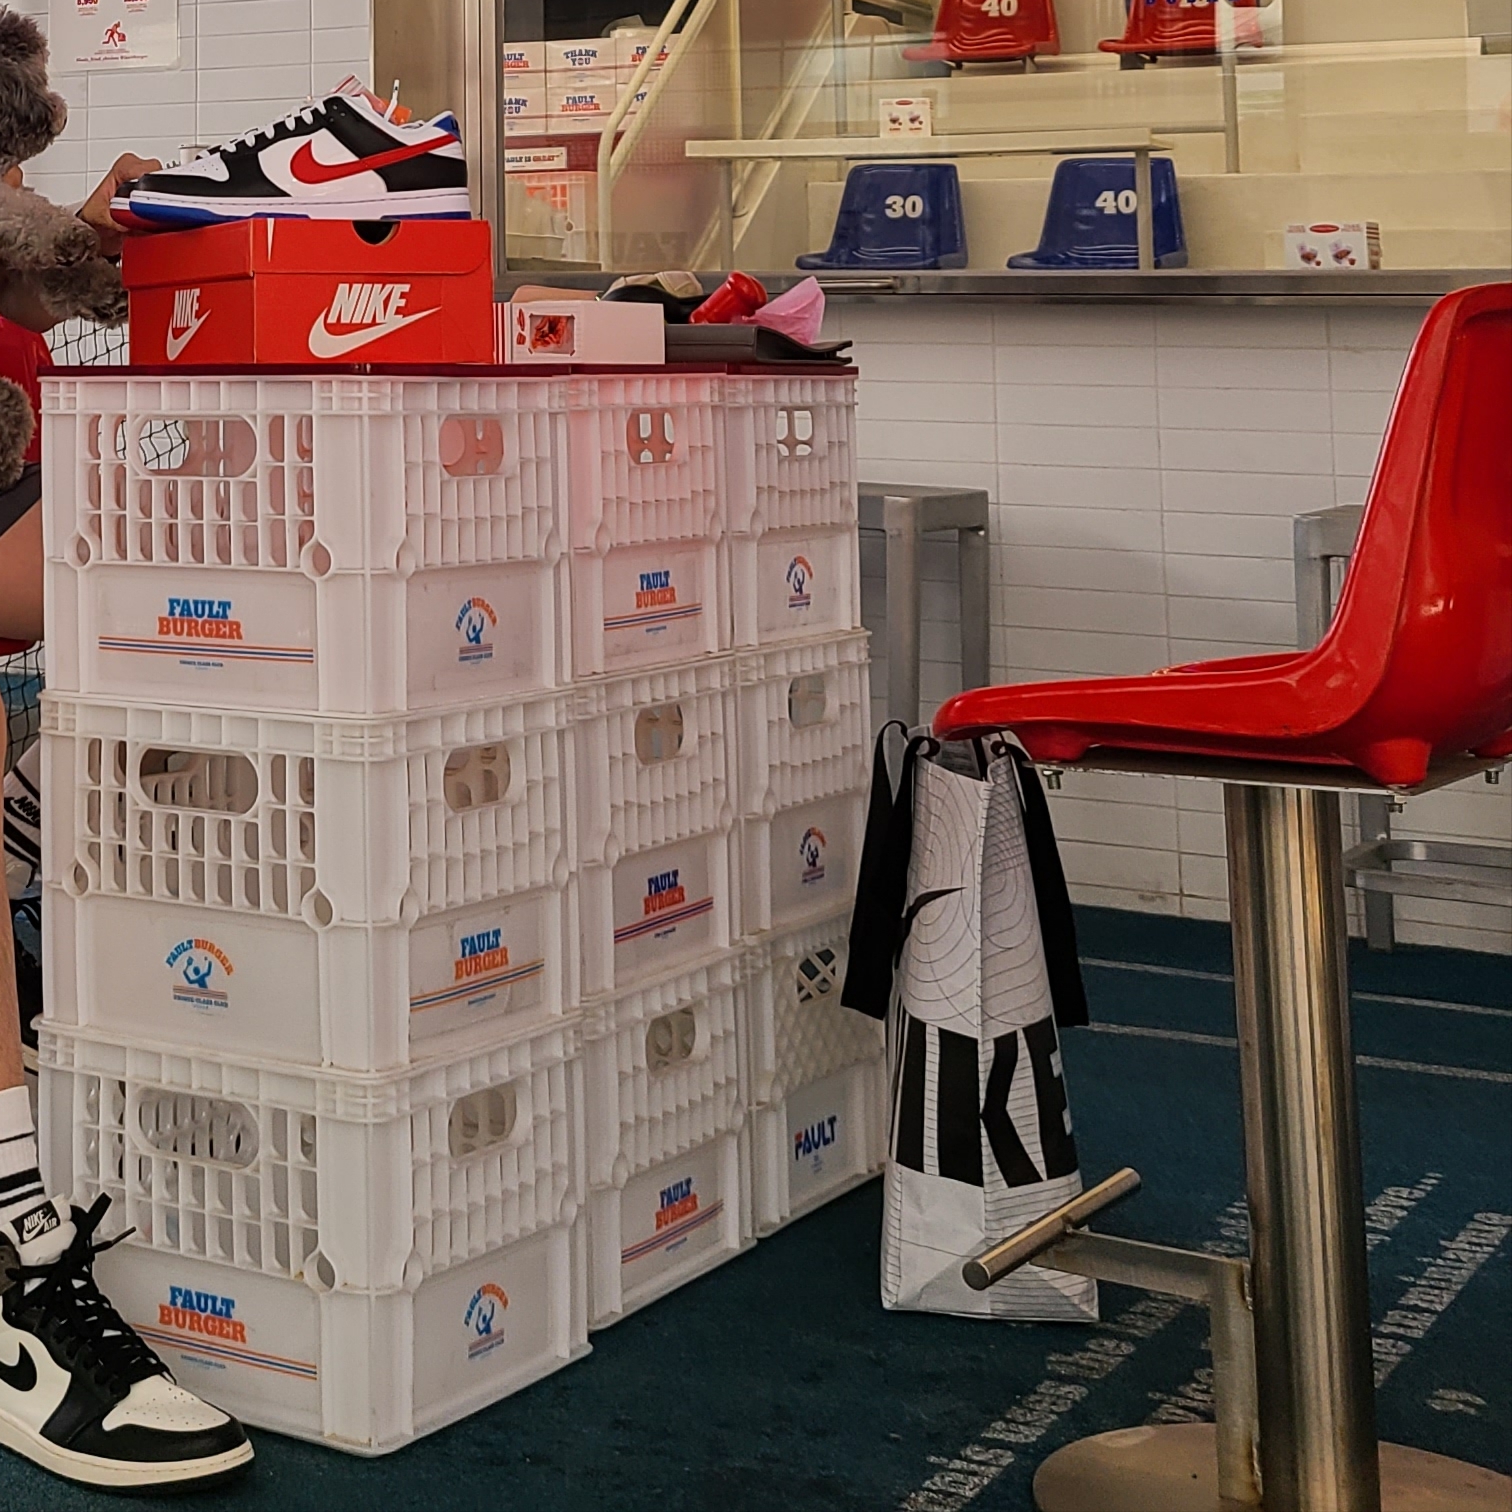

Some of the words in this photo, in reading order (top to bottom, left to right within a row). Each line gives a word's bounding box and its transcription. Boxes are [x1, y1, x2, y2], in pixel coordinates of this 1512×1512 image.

[563, 48, 598, 59] THANK
[884, 194, 924, 219] 30
[1094, 190, 1138, 215] 40
[172, 288, 201, 329] NIKE
[326, 283, 411, 325] NIKE
[639, 570, 671, 592] FAULT
[168, 597, 232, 620] FAULT
[635, 586, 677, 609] BURGER
[157, 616, 244, 640] BURGER
[648, 869, 679, 896] FAULT
[460, 928, 502, 959] FAULT
[454, 945, 509, 981] BURGER
[794, 1115, 837, 1161] FAULT
[660, 1177, 693, 1210] FAULT
[23, 1209, 46, 1231] NIKE
[43, 1217, 58, 1233] AIR
[169, 1285, 236, 1319] FAULT
[159, 1303, 247, 1345] BURGER
